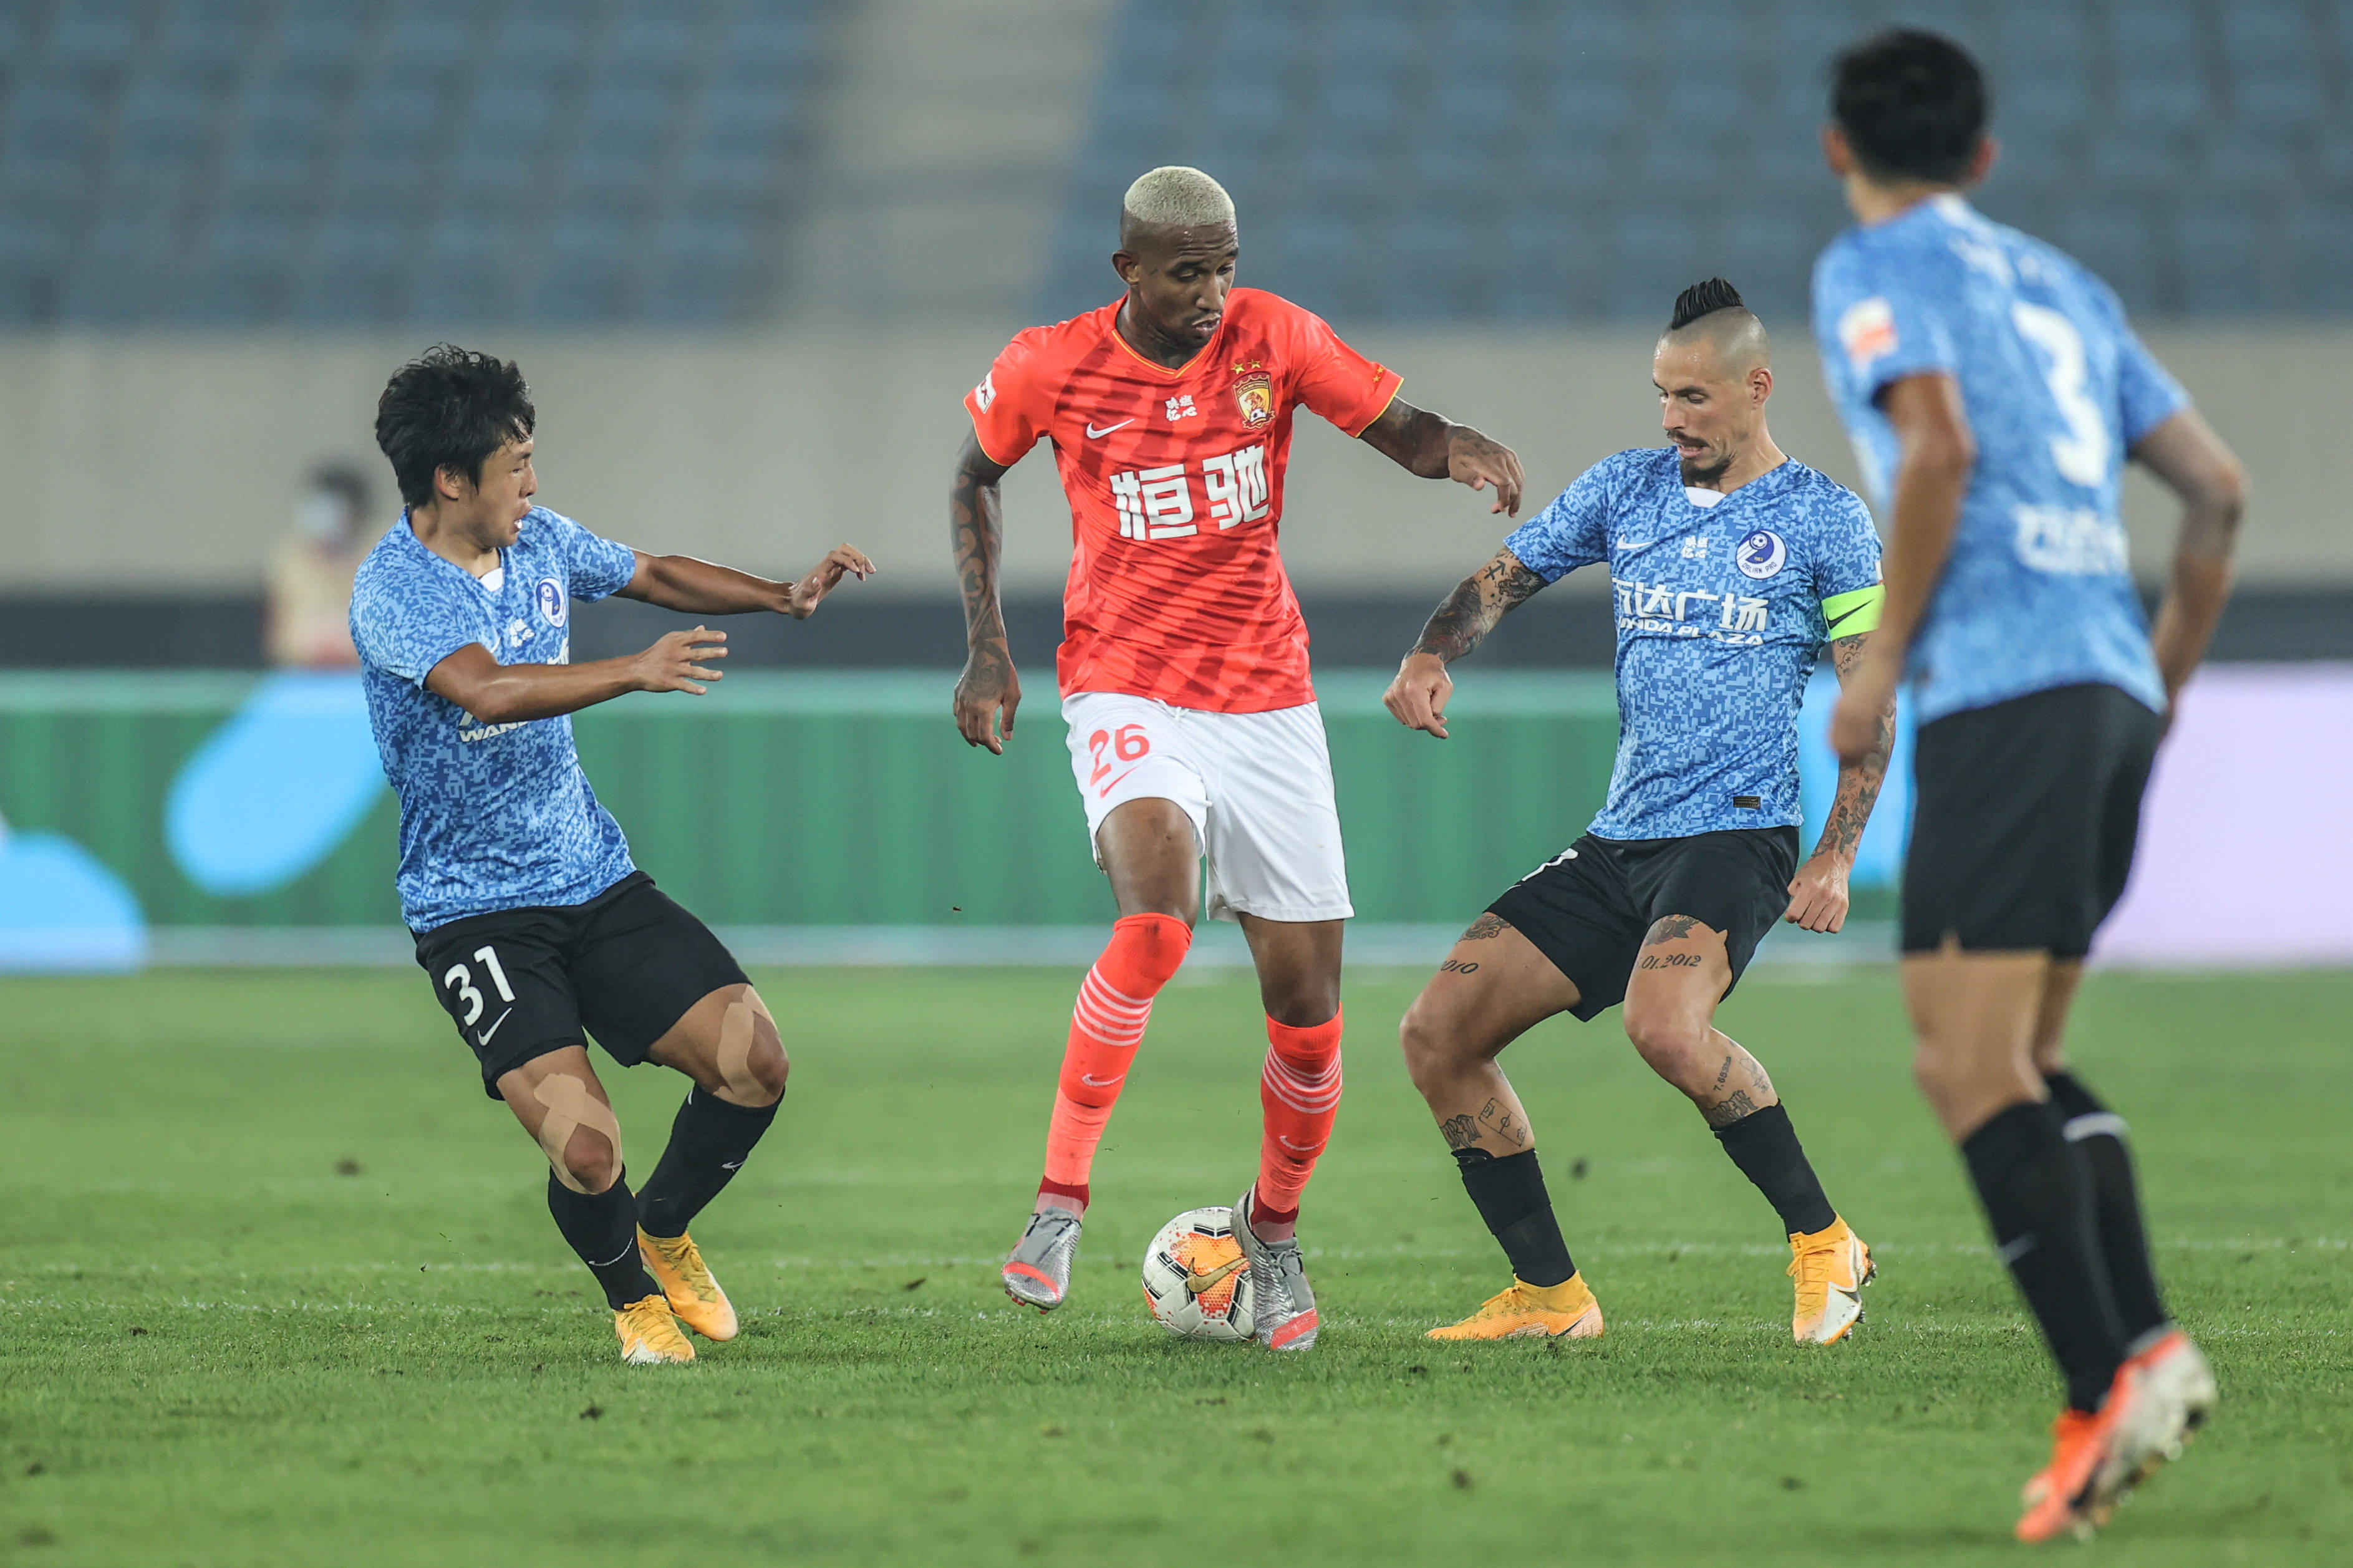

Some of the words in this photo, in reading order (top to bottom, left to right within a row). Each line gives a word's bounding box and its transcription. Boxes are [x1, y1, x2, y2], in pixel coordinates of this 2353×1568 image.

[2009, 297, 2110, 490] 3
[1109, 445, 1270, 541] 恒驰
[1619, 617, 1673, 633] ANDA
[1677, 625, 1764, 646] PLAZA
[459, 721, 529, 743] WAN
[1088, 723, 1150, 787] 26
[444, 945, 516, 1027] 31
